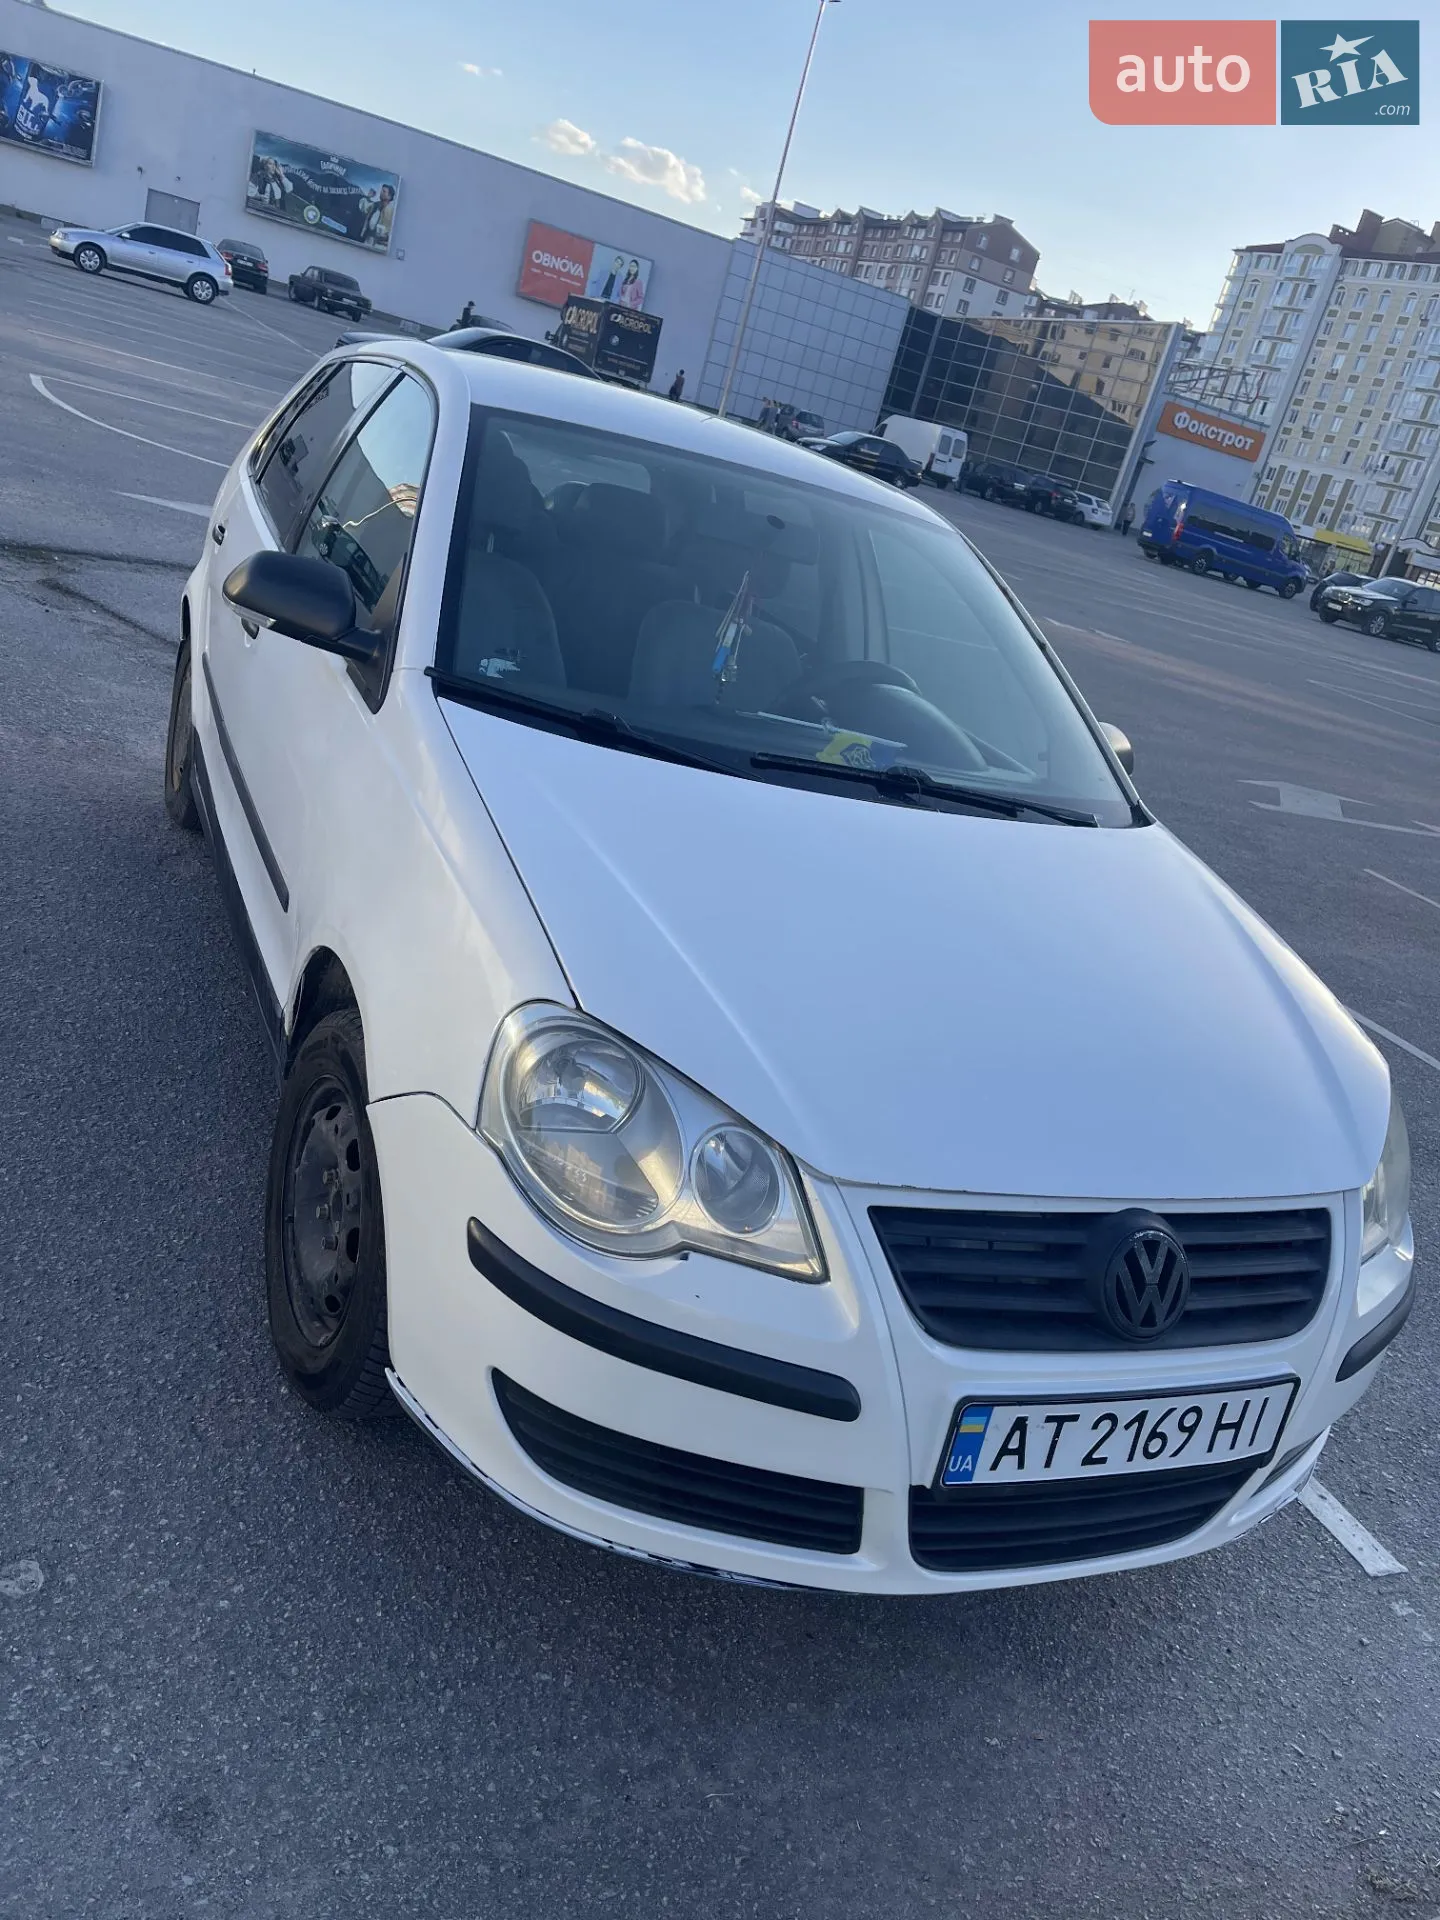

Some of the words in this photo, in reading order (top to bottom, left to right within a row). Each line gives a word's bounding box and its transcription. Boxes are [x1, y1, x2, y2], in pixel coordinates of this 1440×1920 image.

[1174, 411, 1254, 450] Фокстрот
[989, 1415, 1081, 1471] AT
[1081, 1404, 1203, 1467] 2169
[1206, 1397, 1269, 1453] HI
[948, 1454, 973, 1472] UA
